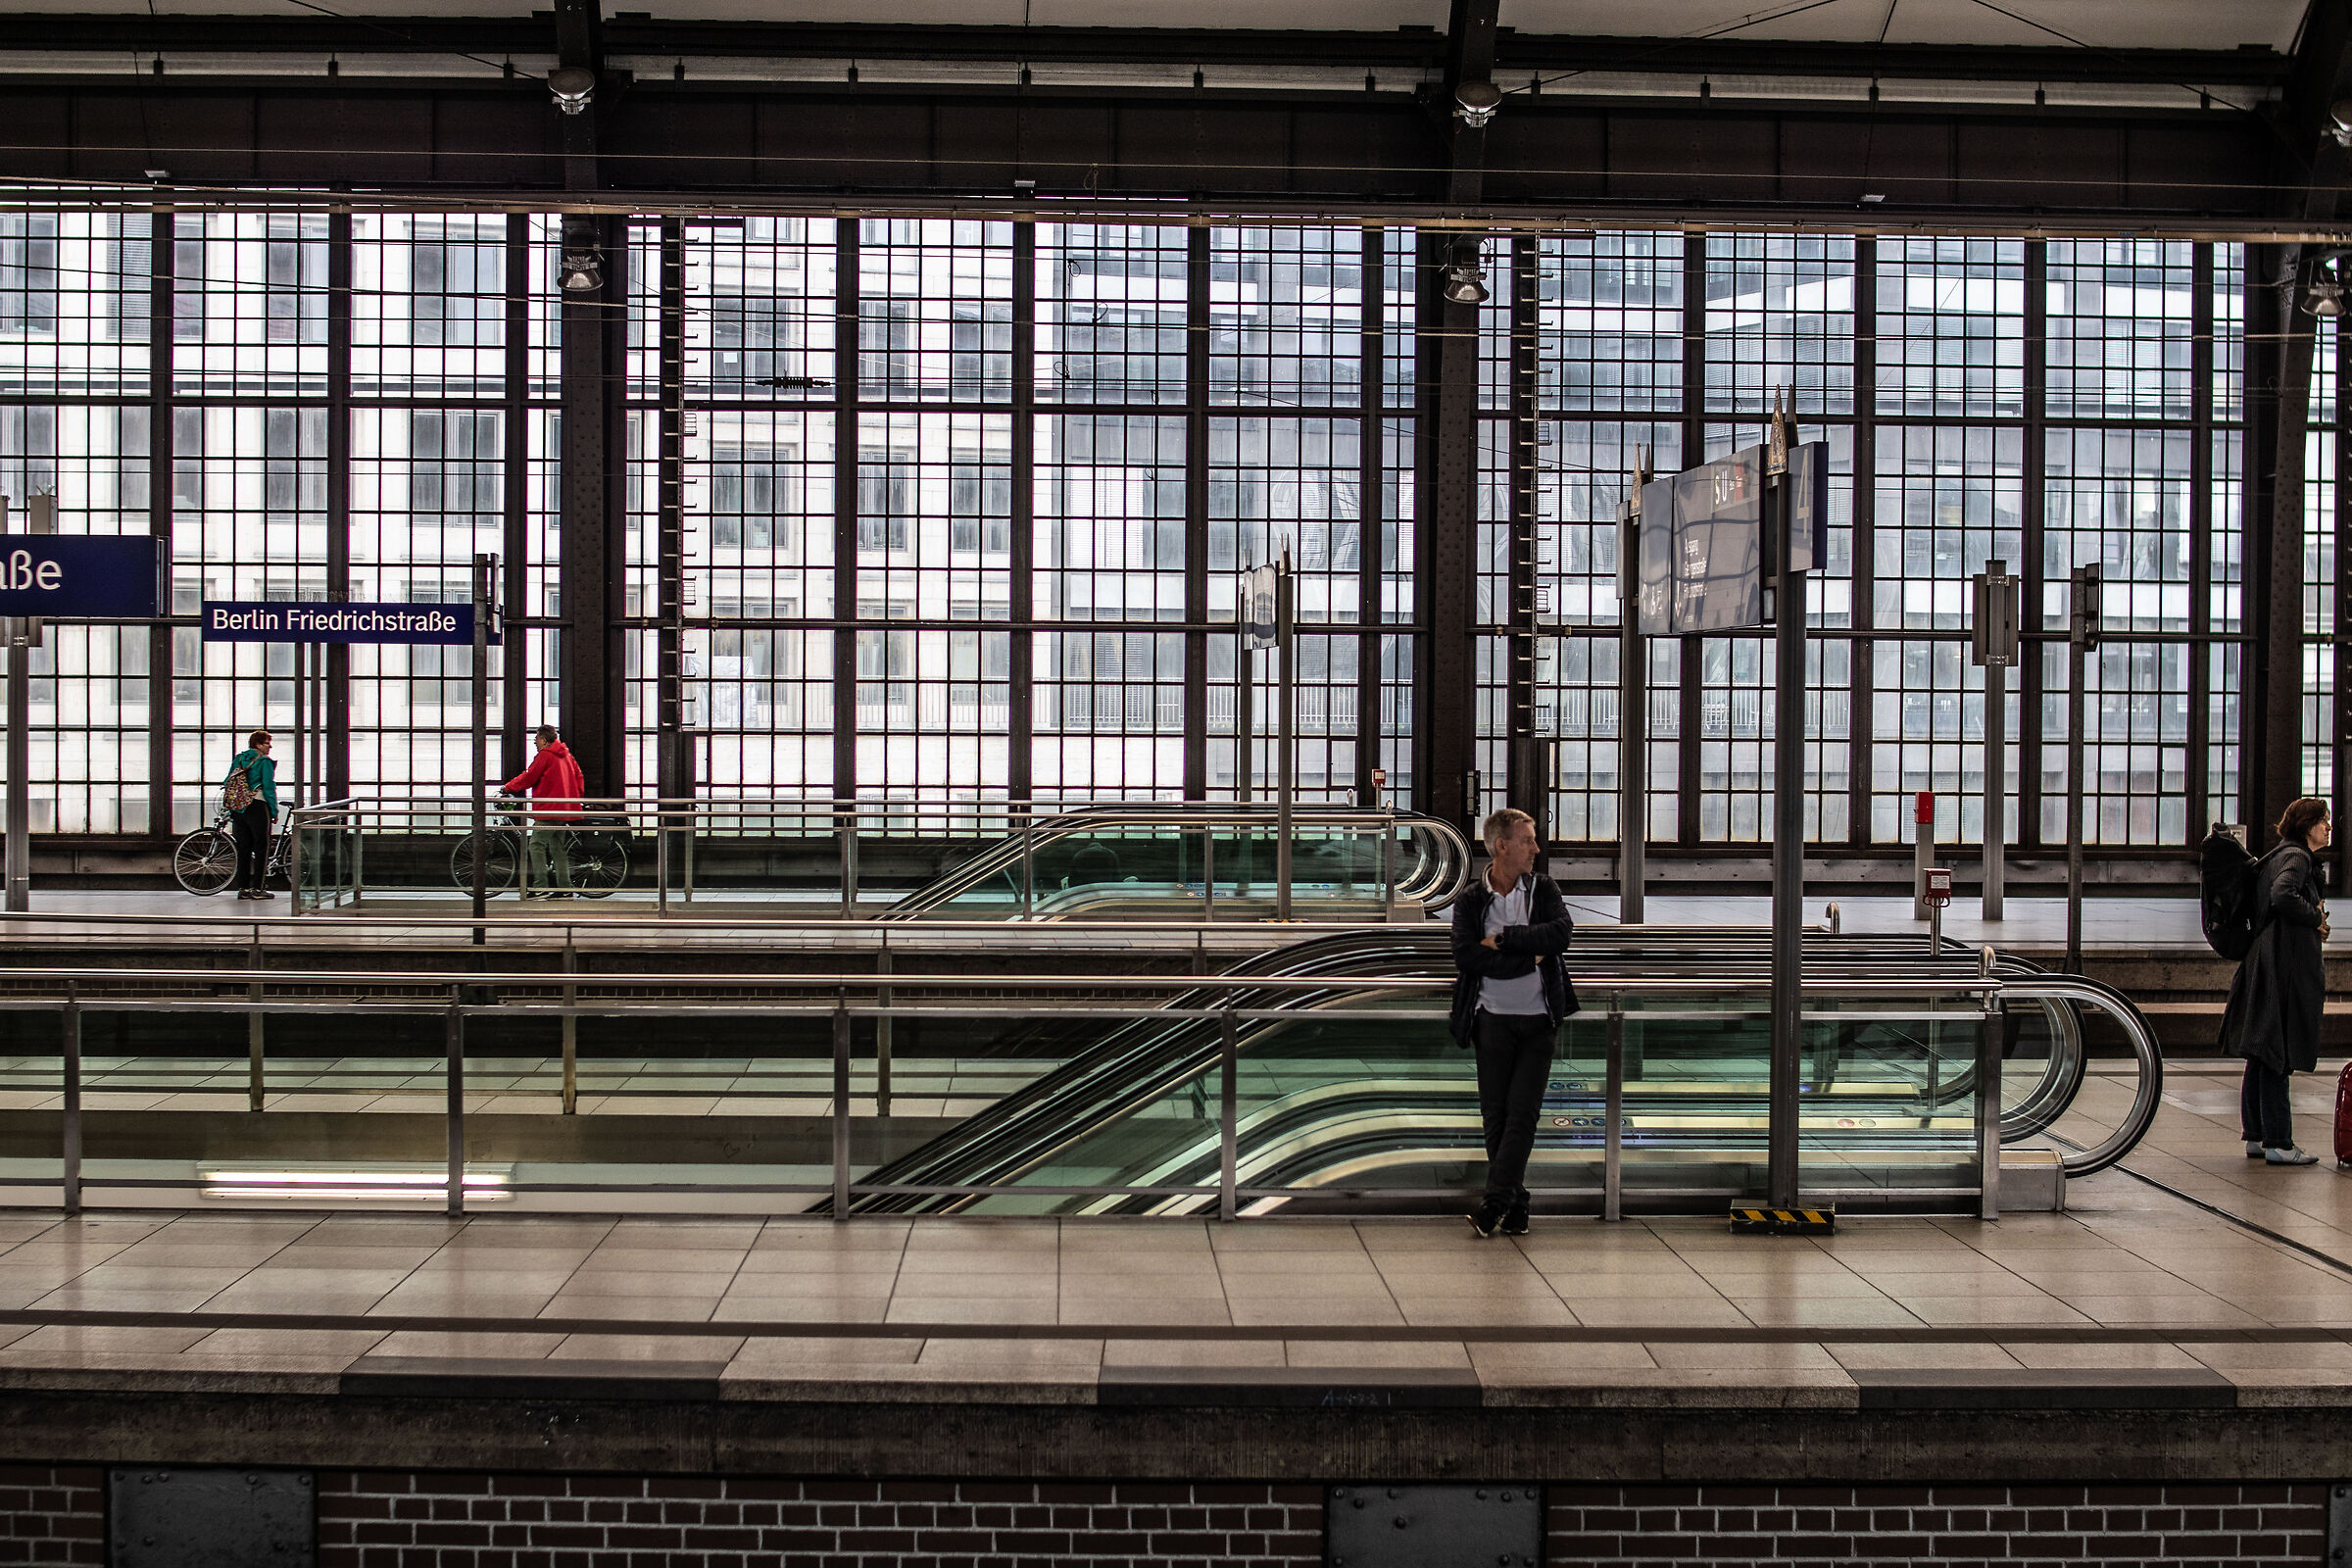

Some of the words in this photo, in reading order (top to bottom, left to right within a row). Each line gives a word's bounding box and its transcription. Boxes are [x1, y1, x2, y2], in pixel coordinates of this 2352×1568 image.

[1715, 475, 1721, 506] S
[1722, 470, 1728, 503] U
[1796, 449, 1809, 539] 4
[213, 609, 278, 632] Berlin
[286, 609, 457, 632] Friedrichstraße
